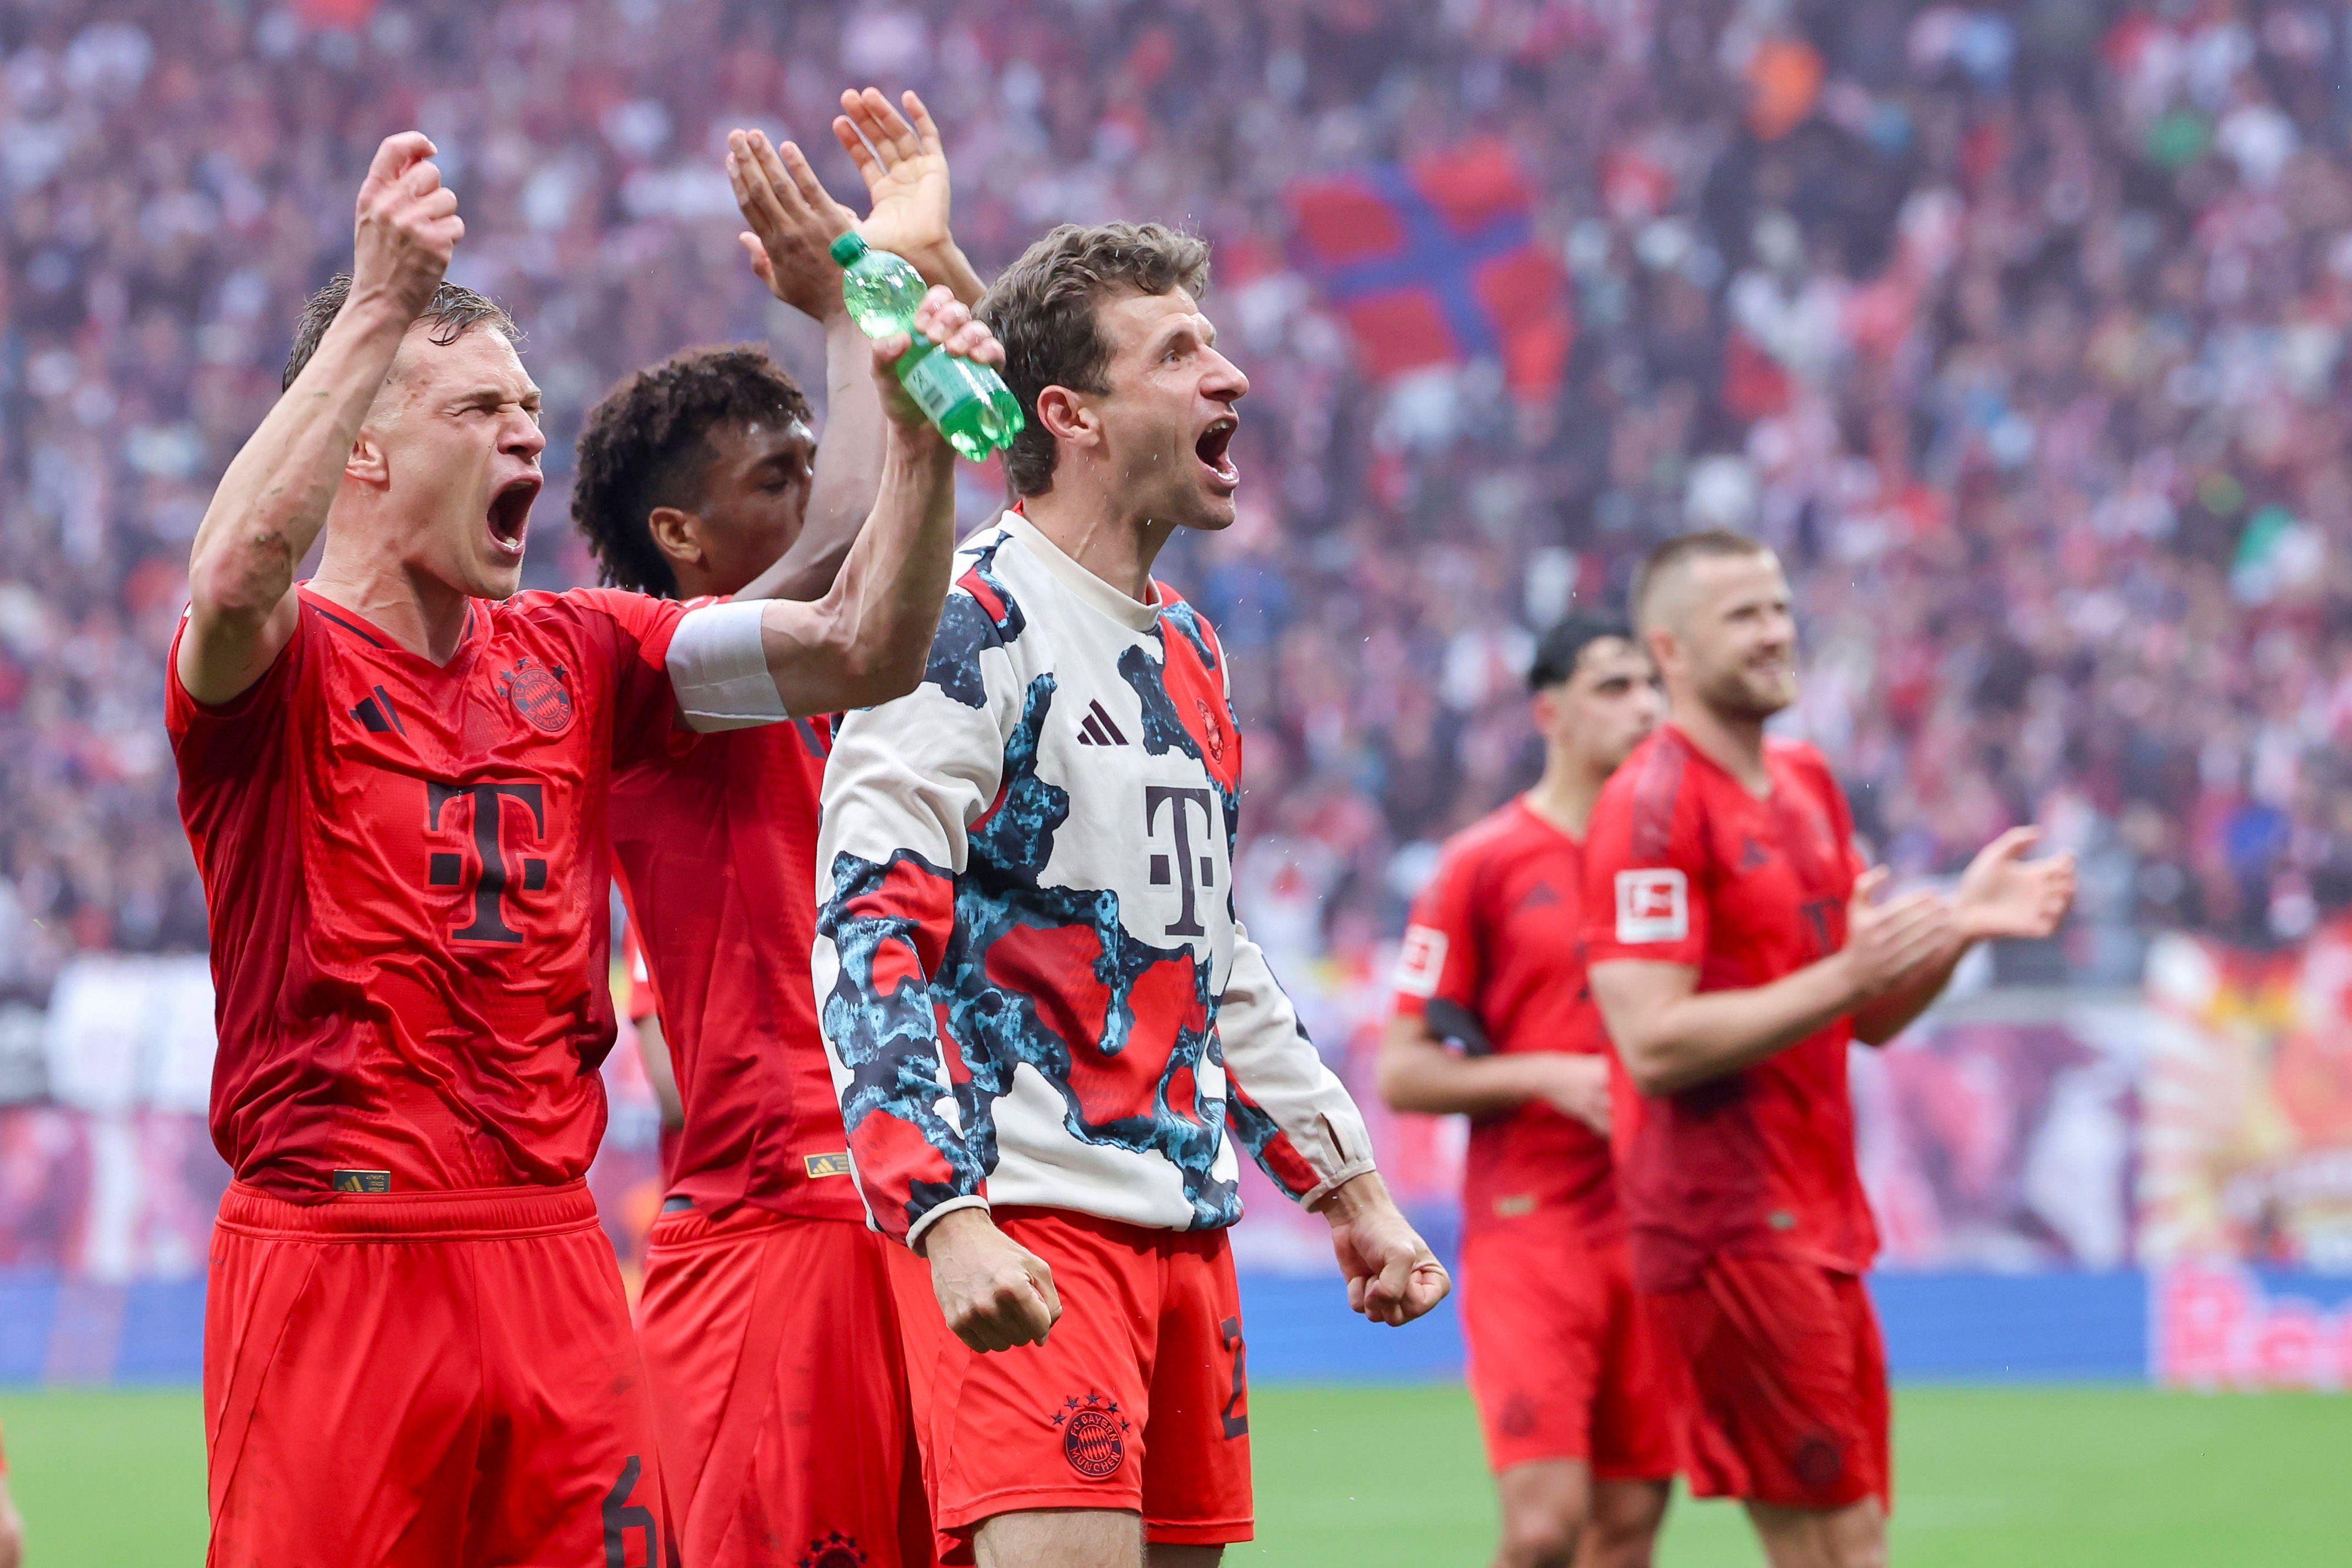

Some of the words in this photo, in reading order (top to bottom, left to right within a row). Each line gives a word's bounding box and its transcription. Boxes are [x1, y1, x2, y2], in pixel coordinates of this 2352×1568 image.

[427, 780, 547, 943] T
[1145, 785, 1213, 937] T
[1071, 1422, 1081, 1436] FC
[1081, 1415, 1118, 1442] BAYERN
[602, 1455, 657, 1568] 6
